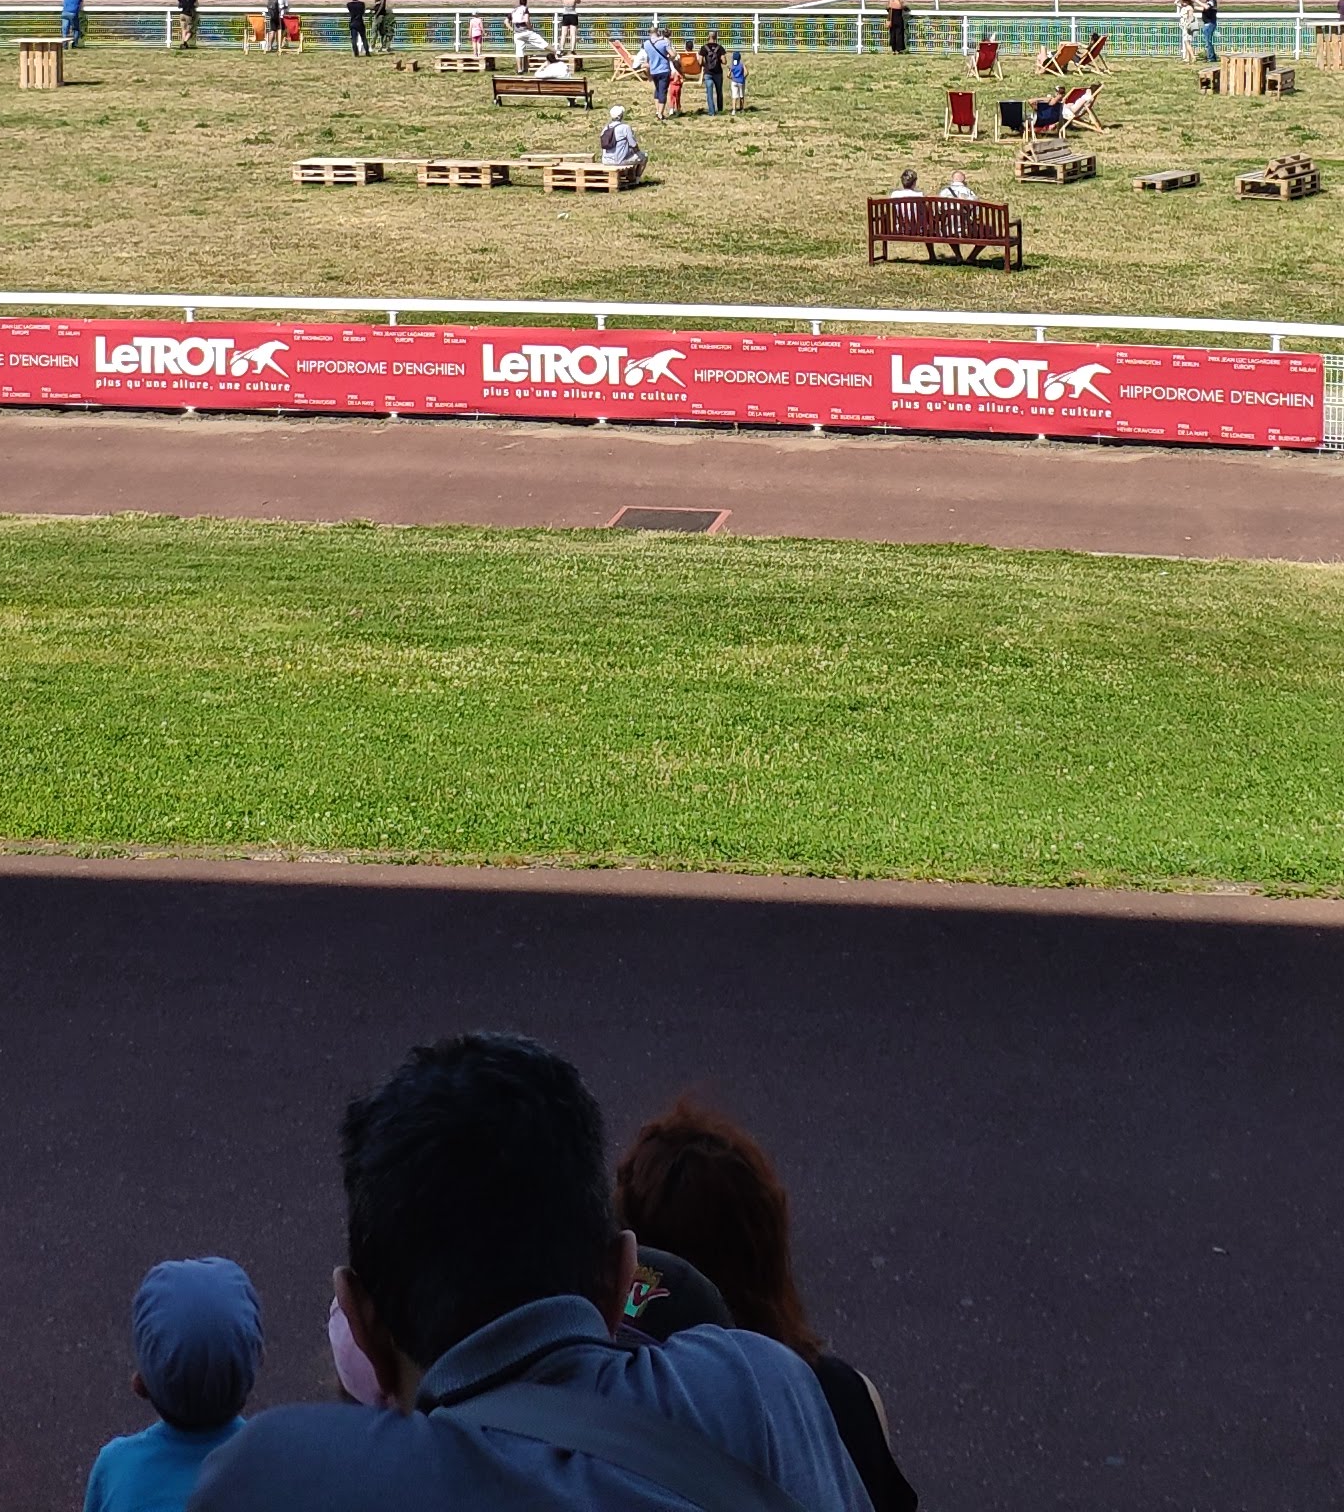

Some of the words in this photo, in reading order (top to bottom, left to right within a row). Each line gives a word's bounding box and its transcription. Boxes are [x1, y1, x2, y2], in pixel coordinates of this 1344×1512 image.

[9, 353, 79, 367] D'ENGHIEN
[95, 336, 234, 376] LeTROT
[482, 344, 628, 385] LeTROT
[296, 360, 387, 375] HIPPODROME
[392, 362, 465, 376] D'ENGHIEN
[95, 377, 121, 390] plus
[219, 382, 241, 390] une
[245, 381, 291, 392] culture
[694, 369, 790, 385] HIPPODROME
[795, 372, 872, 387] D'ENGHIEN
[891, 355, 1048, 401] LeTROT
[483, 386, 510, 399] plus
[612, 391, 635, 400] une
[640, 390, 687, 402] culture
[1120, 385, 1224, 403] HIPPODROME
[1230, 390, 1314, 407] D'ENGHIEN
[891, 399, 920, 411] plus
[1030, 406, 1055, 416] une
[1061, 404, 1112, 418] culture
